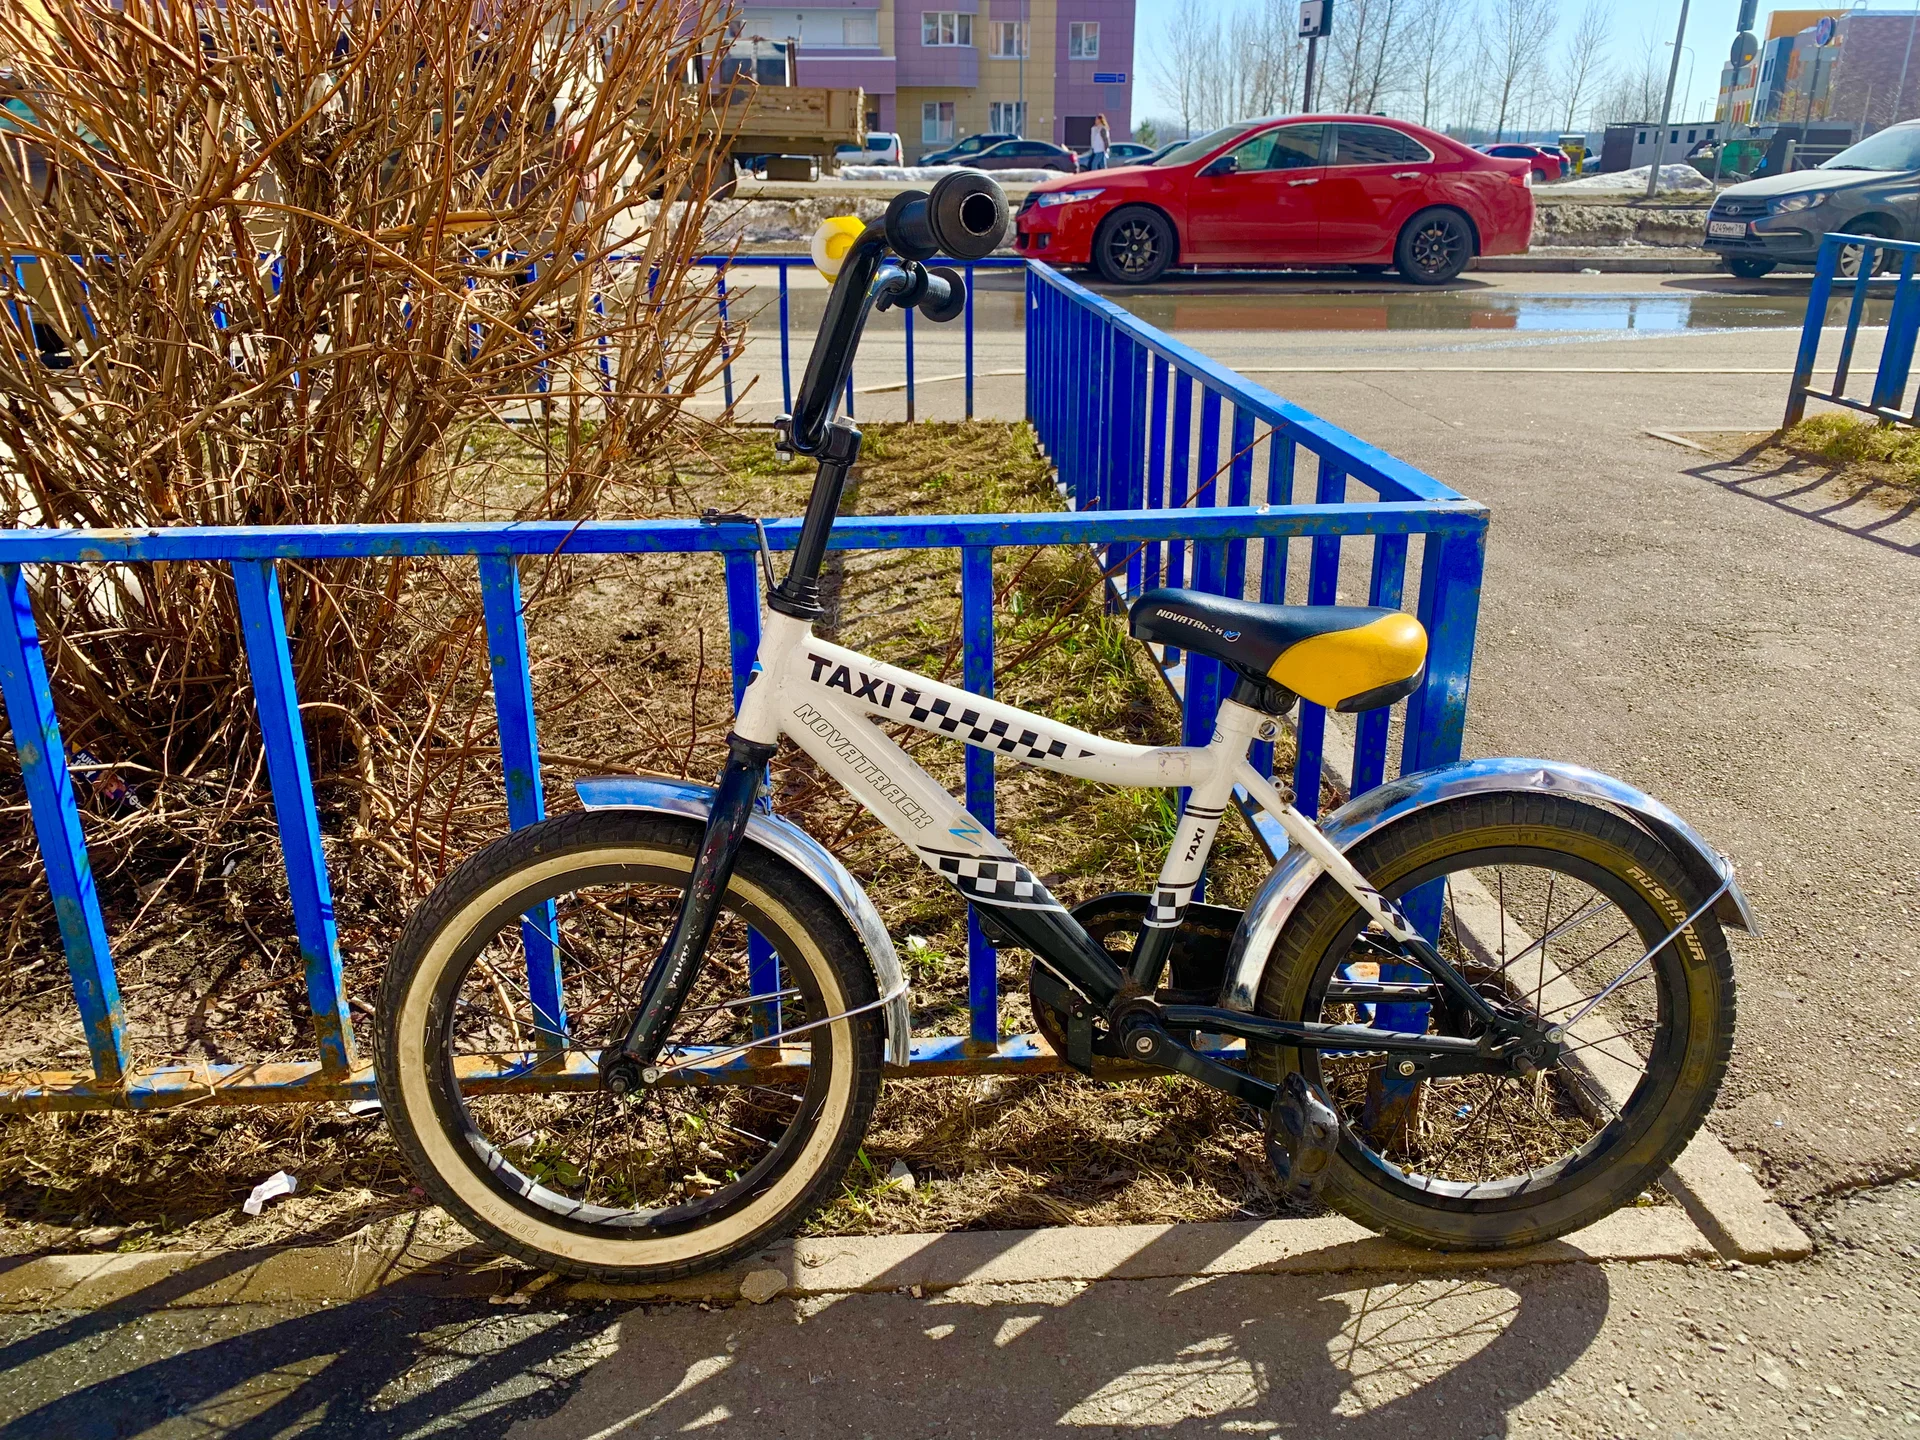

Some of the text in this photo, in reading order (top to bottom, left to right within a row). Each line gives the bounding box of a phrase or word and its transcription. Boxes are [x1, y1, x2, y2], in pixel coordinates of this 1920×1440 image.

[807, 652, 896, 709] TAXI
[793, 703, 935, 831] NOVATRACK
[1185, 827, 1206, 862] TAXI
[482, 1203, 539, 1239] PONELY
